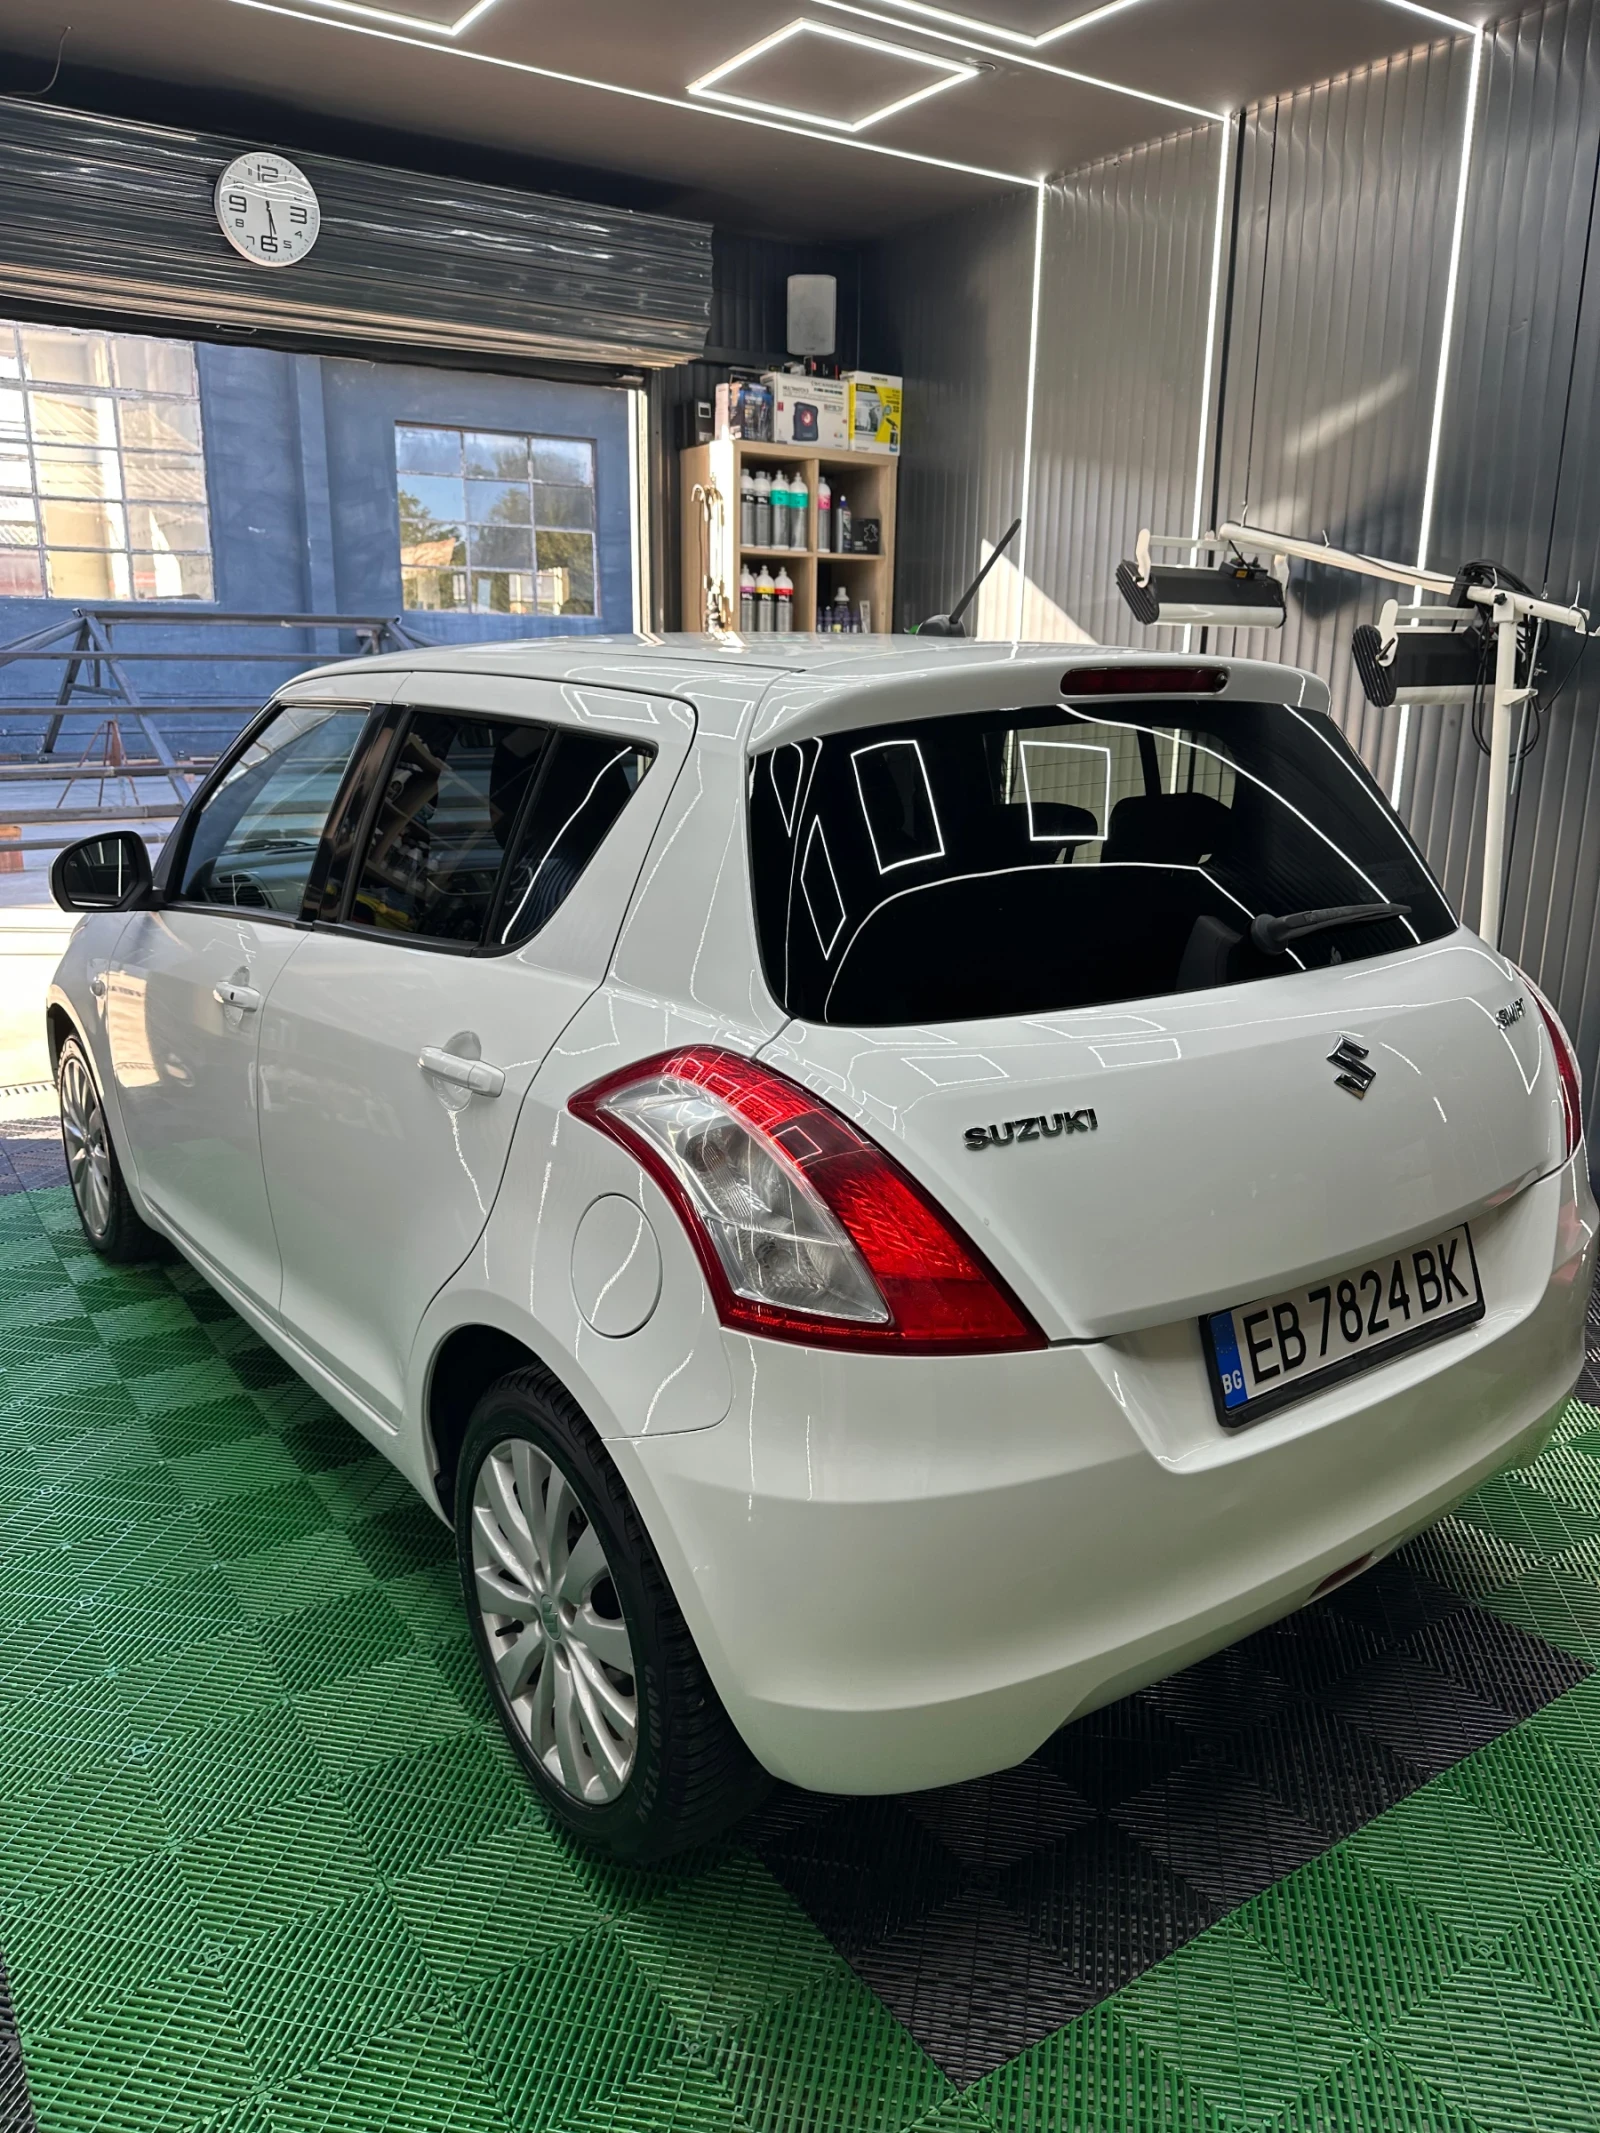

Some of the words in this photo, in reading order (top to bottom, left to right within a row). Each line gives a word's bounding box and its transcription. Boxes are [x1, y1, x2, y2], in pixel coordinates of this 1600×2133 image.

[257, 164, 278, 183] 12
[229, 194, 247, 213] 9
[235, 219, 244, 228] 8
[290, 206, 307, 224] 3
[246, 236, 255, 245] 7
[261, 234, 278, 253] 6
[295, 231, 303, 239] 4
[283, 241, 292, 249] 5
[963, 1107, 1099, 1151] SUZUKI
[1243, 1301, 1307, 1384] EB
[1307, 1259, 1411, 1357] 7824
[1411, 1237, 1470, 1314] BK
[1221, 1369, 1243, 1395] BG
